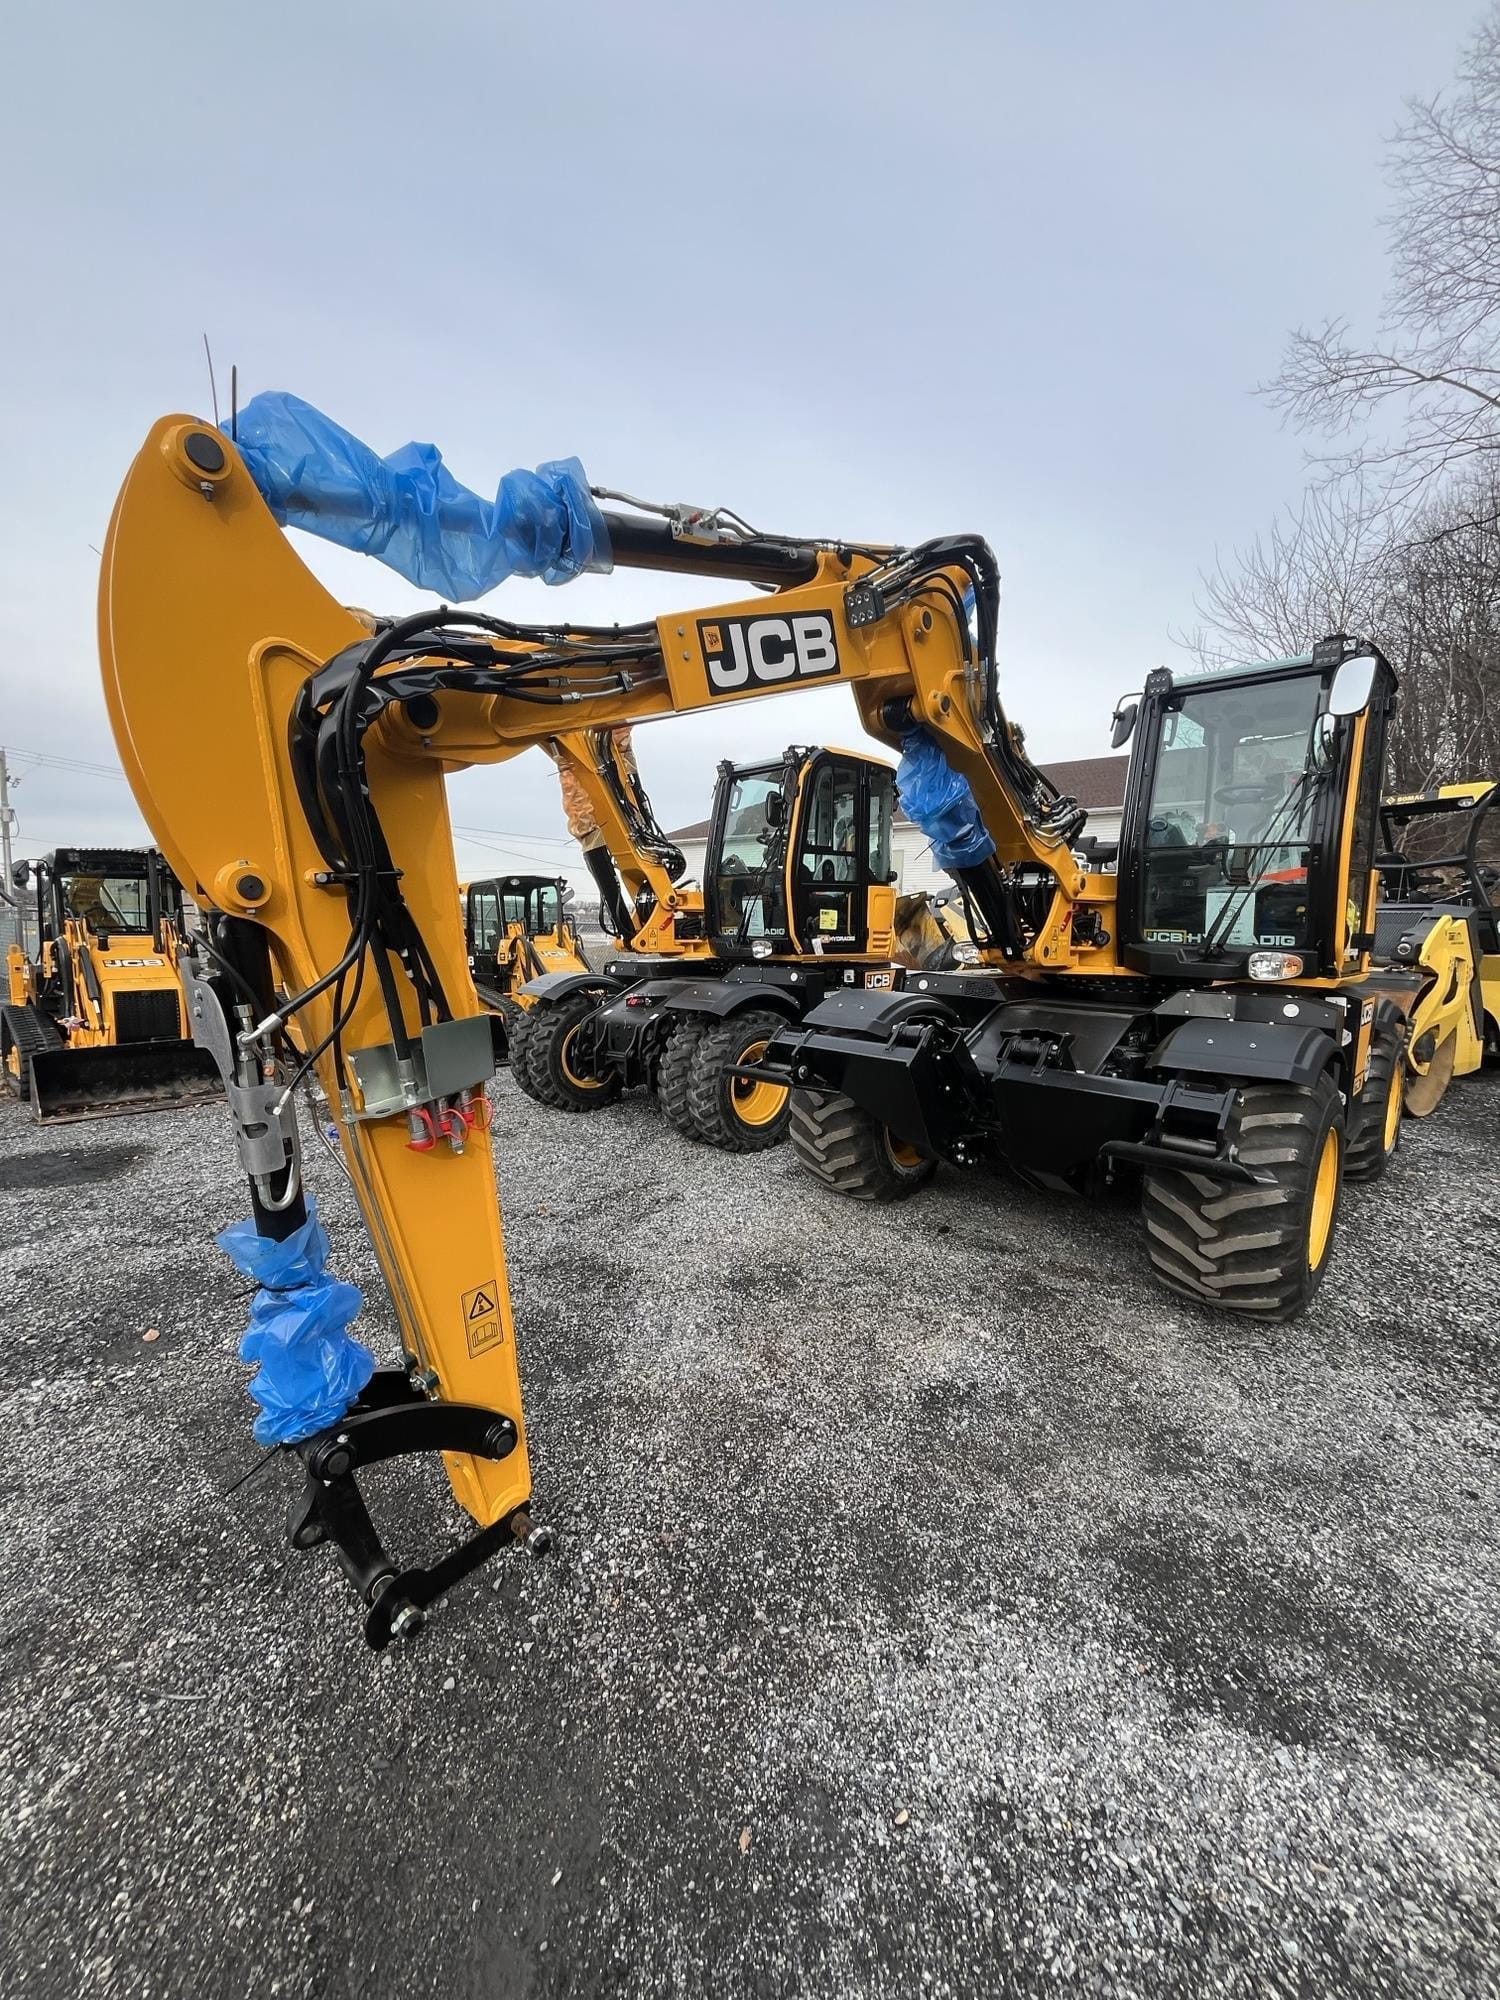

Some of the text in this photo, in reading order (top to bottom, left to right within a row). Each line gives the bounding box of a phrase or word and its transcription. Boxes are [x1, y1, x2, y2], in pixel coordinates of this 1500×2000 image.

[708, 616, 836, 688] JCB
[1147, 932, 1183, 943] JCB
[867, 974, 890, 989] JCB
